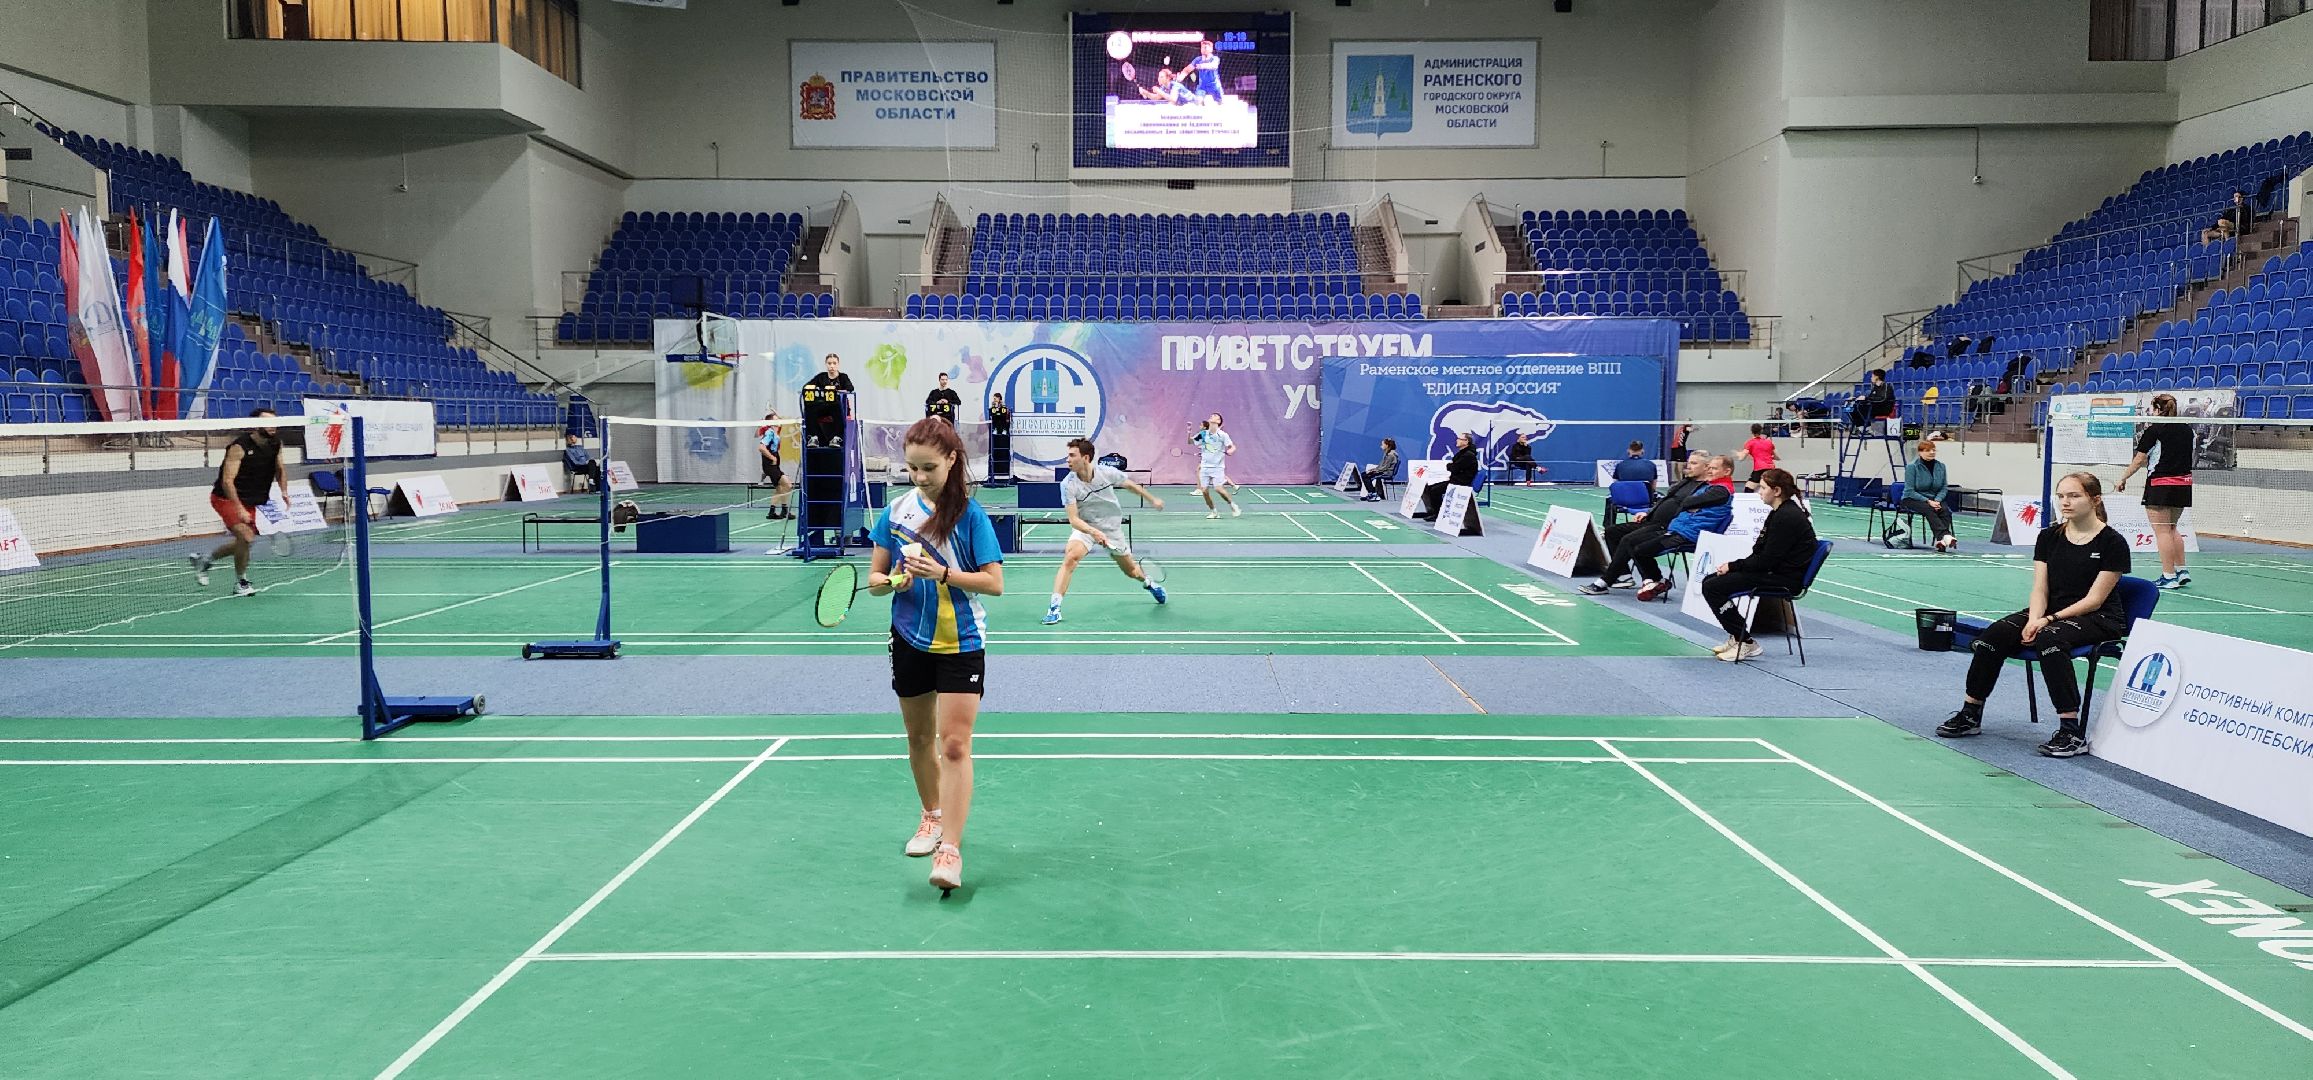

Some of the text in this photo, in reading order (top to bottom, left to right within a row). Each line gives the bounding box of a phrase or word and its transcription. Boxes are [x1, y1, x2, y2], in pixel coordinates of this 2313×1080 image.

[1424, 58, 1523, 69] АДМИНИСТРАЦИЯ
[840, 71, 989, 84] ПРАВИТЕЛЬСТВО
[1423, 74, 1522, 87] РАМЕНСКОГО
[856, 87, 975, 101] МОСКОВСКОЙ
[1423, 91, 1522, 101] ГОРОДСКОГО ОКРУГА
[875, 107, 956, 120] ОБЛАСТИ
[1435, 102, 1510, 114] МОСКОВСКОЙ
[1446, 118, 1498, 129] ОБЛАСТИ
[1359, 362, 1622, 376] Раменское местное отделение ВПП
[1423, 381, 1562, 396] "ЕДИНАЯ РОССИЯ"
[929, 404, 950, 412] 7 3
[2136, 533, 2154, 546] 25
[2184, 683, 2273, 717] СПОРТИВНЫЙ
